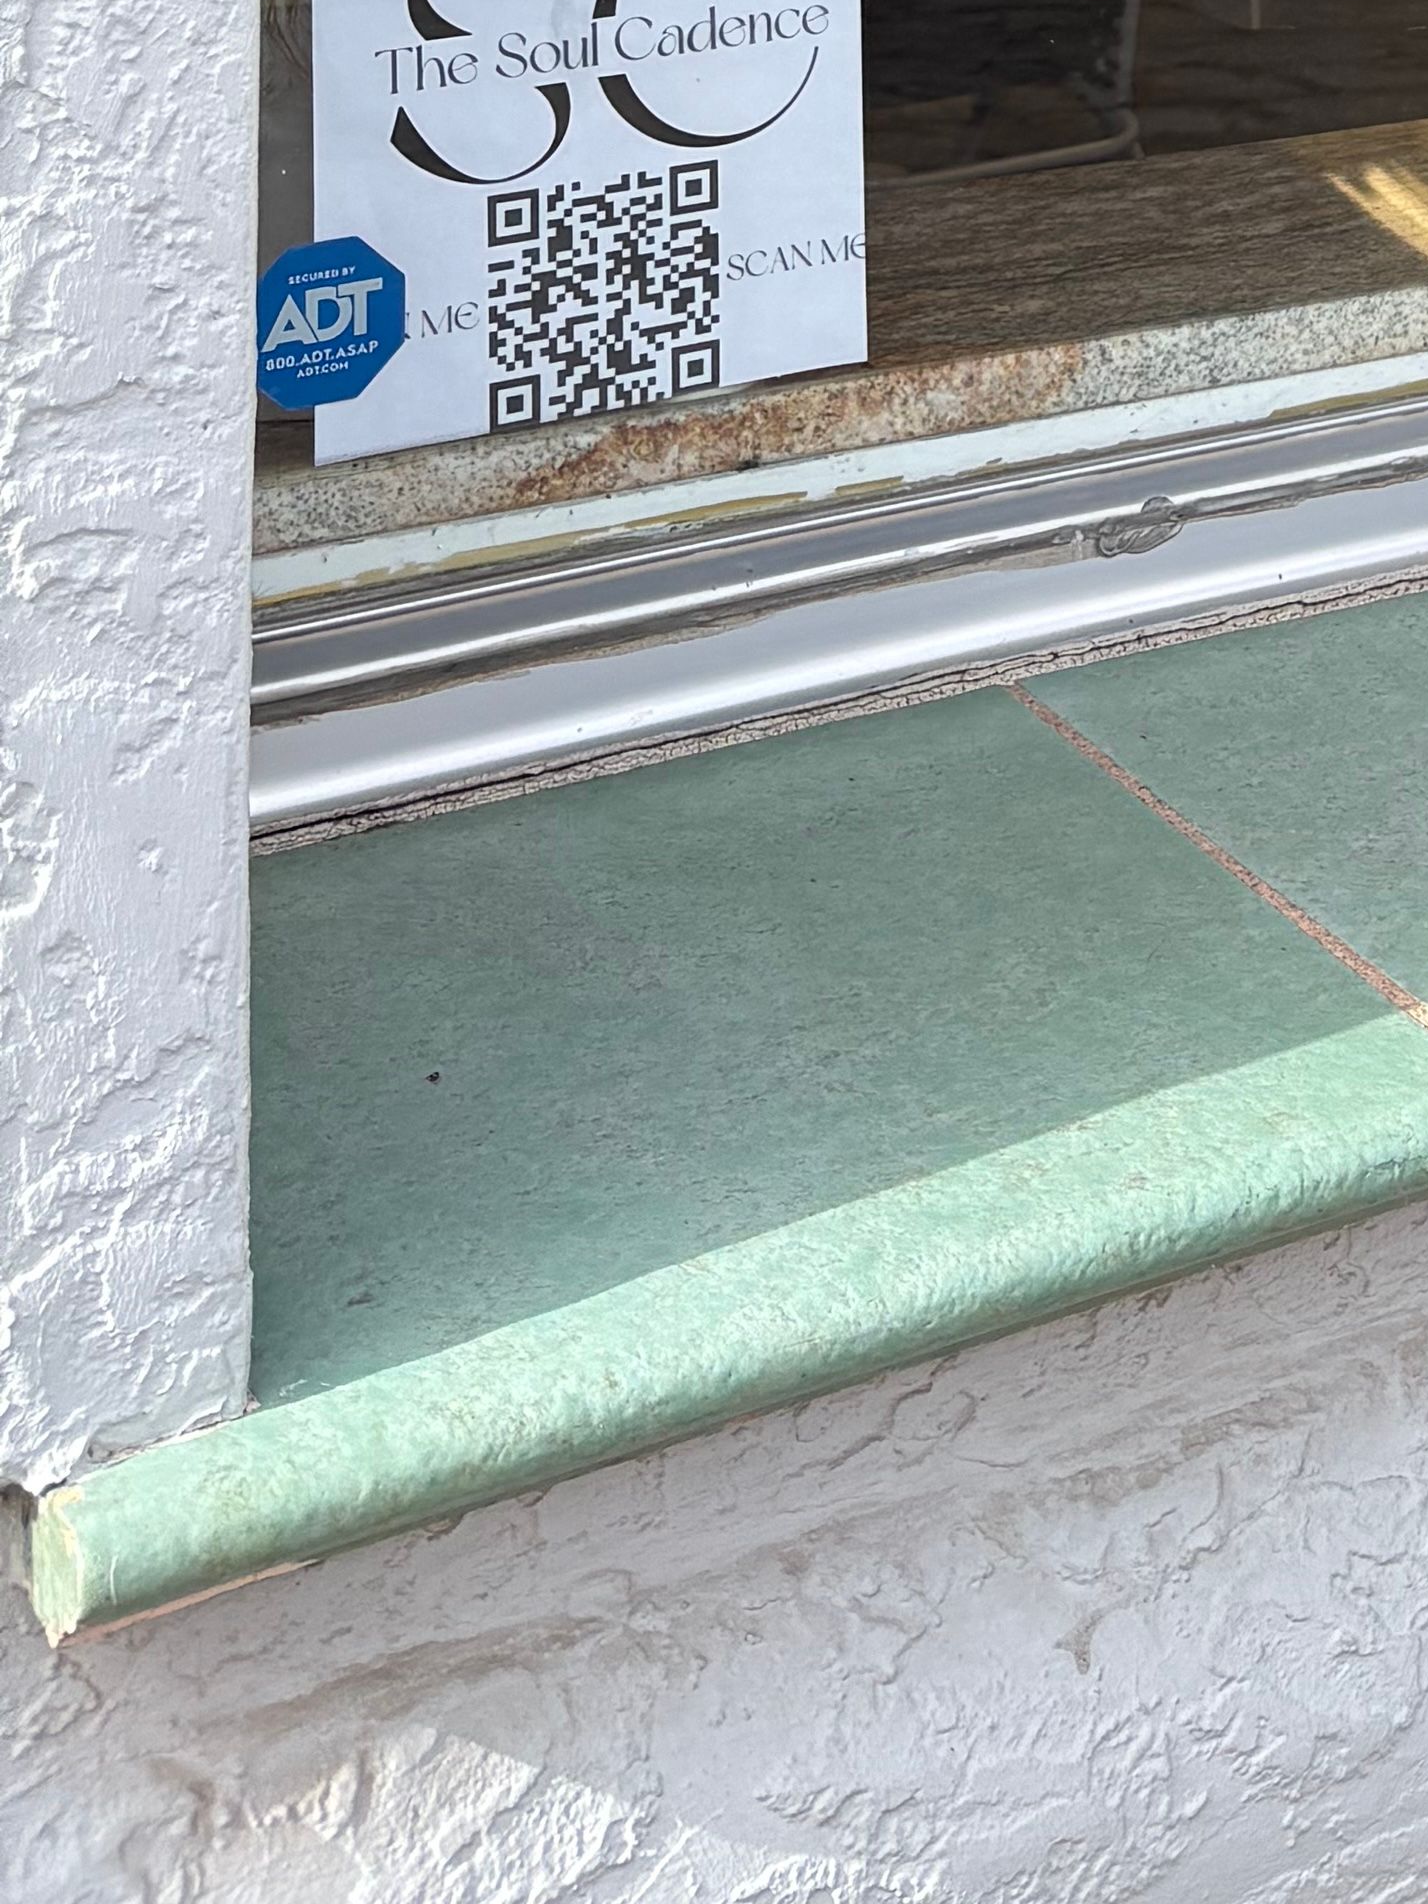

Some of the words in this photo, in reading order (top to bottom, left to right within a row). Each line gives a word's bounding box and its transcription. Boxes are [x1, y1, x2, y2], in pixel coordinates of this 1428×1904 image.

[375, 45, 478, 96] The
[496, 21, 600, 78] Soul
[615, 2, 830, 62] Cadence
[287, 269, 339, 285] SECURED
[341, 265, 356, 276] BY
[726, 240, 813, 281] SCAN
[821, 232, 866, 265] ME
[260, 277, 383, 353] ADT
[420, 301, 480, 339] ME
[264, 340, 379, 371] 800.ADT.ASAP
[296, 361, 349, 378] ADT.COM
